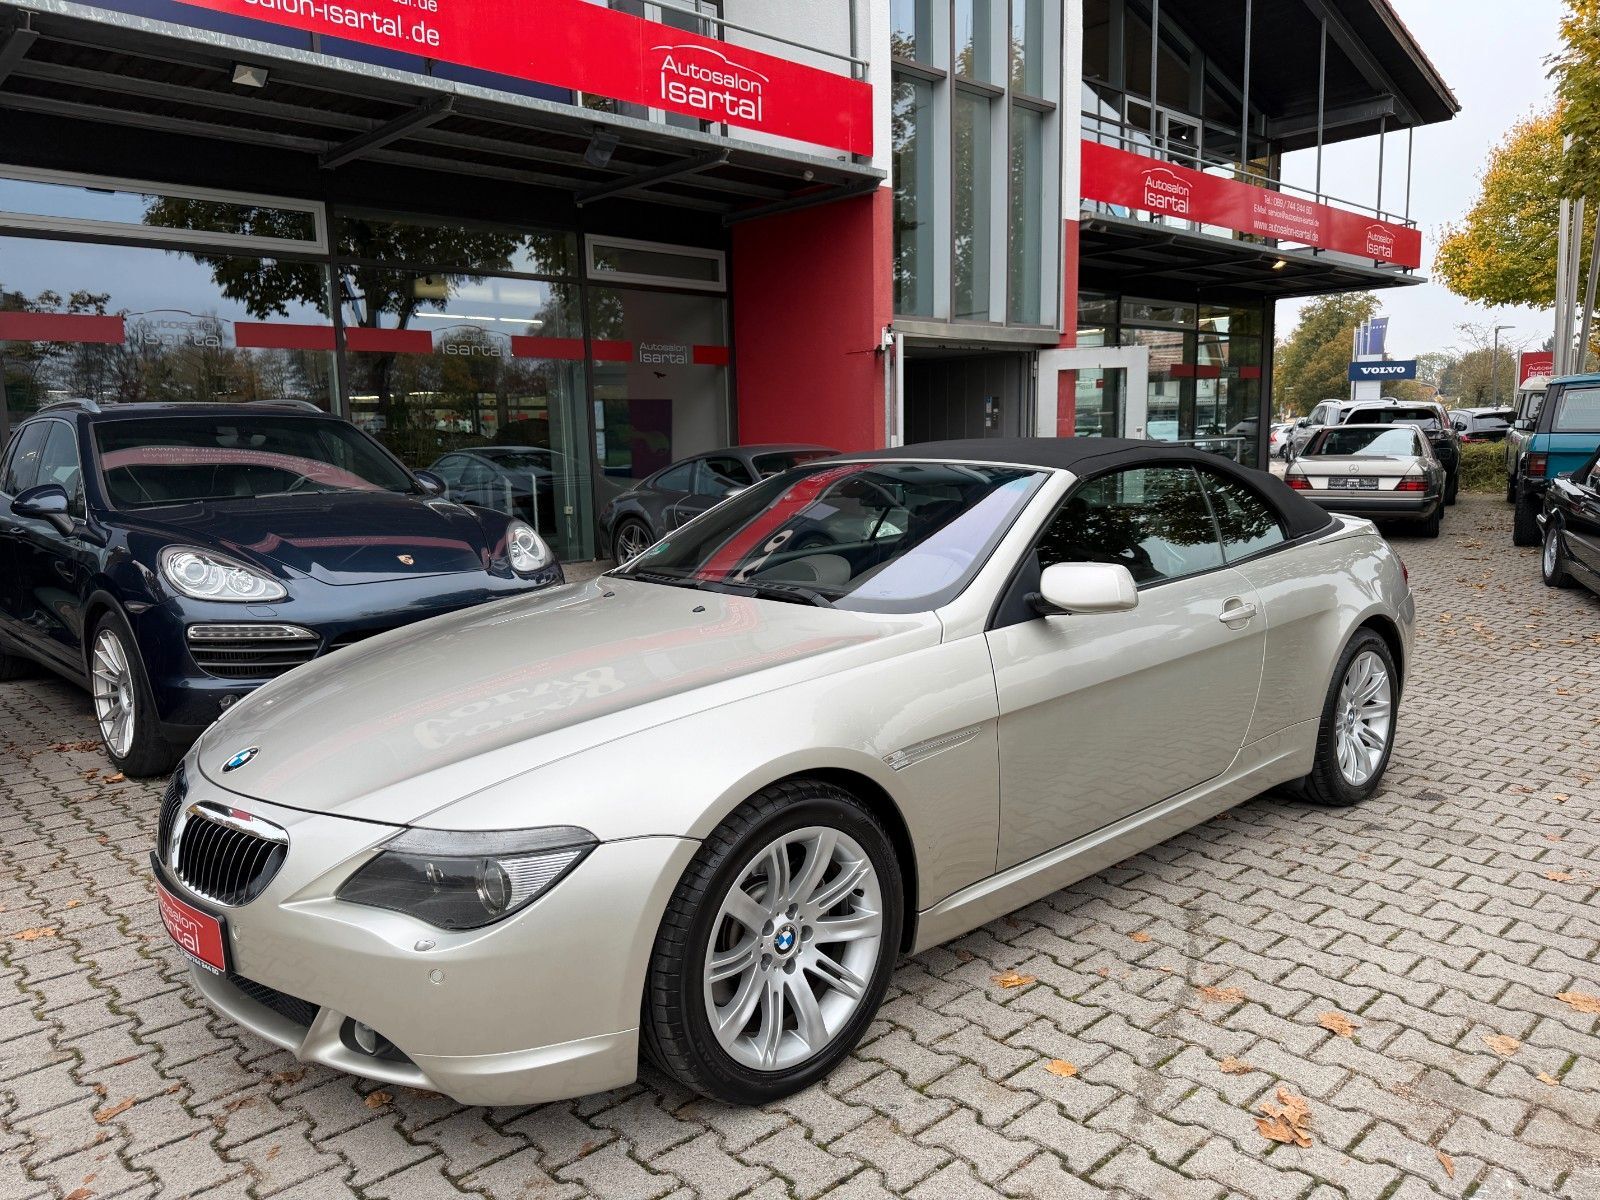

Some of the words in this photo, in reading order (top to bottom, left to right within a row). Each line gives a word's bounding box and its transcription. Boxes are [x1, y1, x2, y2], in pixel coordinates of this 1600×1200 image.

[661, 55, 762, 95] Autosalon
[661, 72, 762, 122] Isartal
[1145, 176, 1189, 196] Autosalon
[1144, 187, 1189, 214] Isartal
[1253, 220, 1319, 242] www.autosalon-isartal.de
[1368, 231, 1394, 245] Autosalon
[1366, 240, 1393, 258] Isartal
[640, 342, 687, 353] Autosalon
[640, 350, 688, 366] Isartal
[1360, 366, 1406, 374] VOLVO
